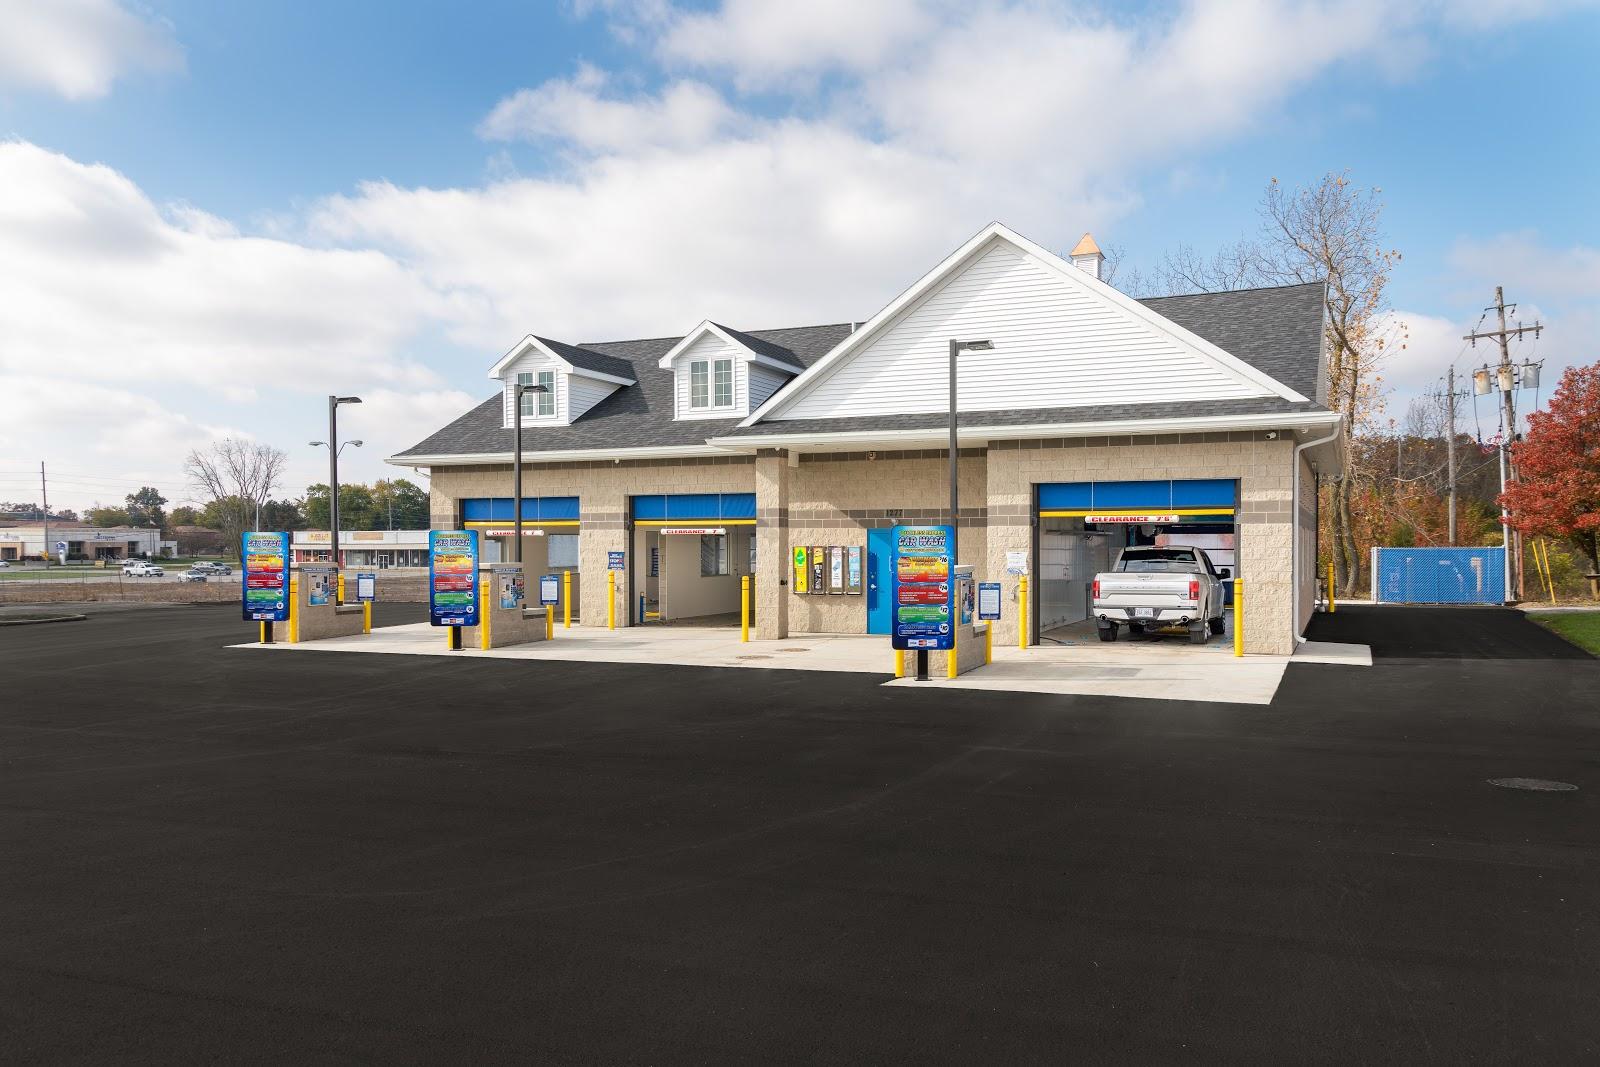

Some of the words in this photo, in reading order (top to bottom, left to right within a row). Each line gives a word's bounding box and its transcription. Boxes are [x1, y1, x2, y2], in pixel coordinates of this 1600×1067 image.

[886, 509, 903, 517] 1277
[898, 536, 917, 547] CAR
[919, 536, 946, 547] WASH
